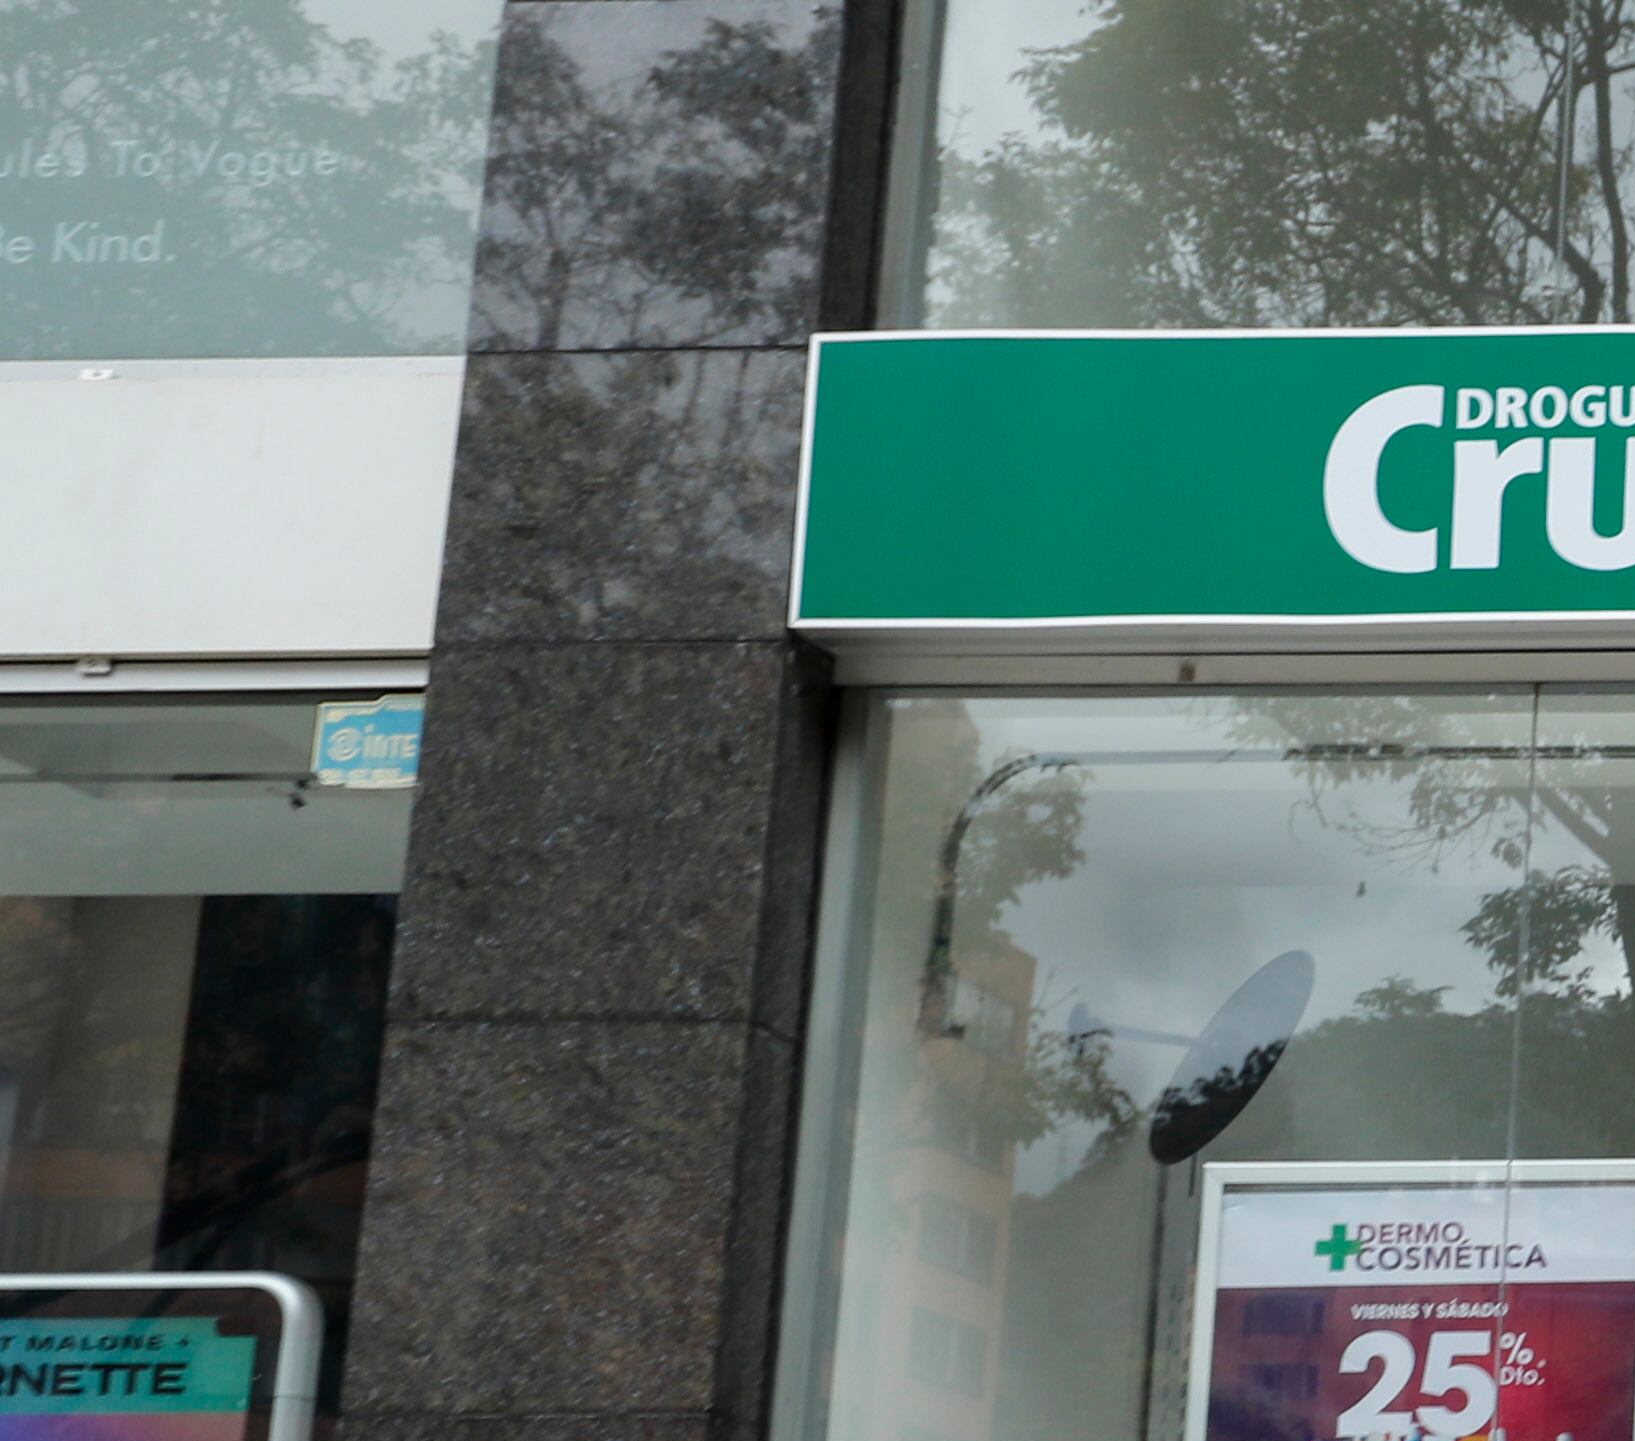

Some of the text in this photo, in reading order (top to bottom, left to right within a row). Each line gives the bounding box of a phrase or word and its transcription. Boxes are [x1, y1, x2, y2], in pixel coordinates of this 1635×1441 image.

[111, 138, 158, 178] To
[191, 138, 341, 188] Vogue
[51, 219, 177, 263] Kind.
[1356, 1222, 1465, 1246] DERMO
[1355, 1238, 1548, 1272] COSMÉTICA
[26, 1334, 166, 1353] MALONE
[1335, 1329, 1498, 1438] 25
